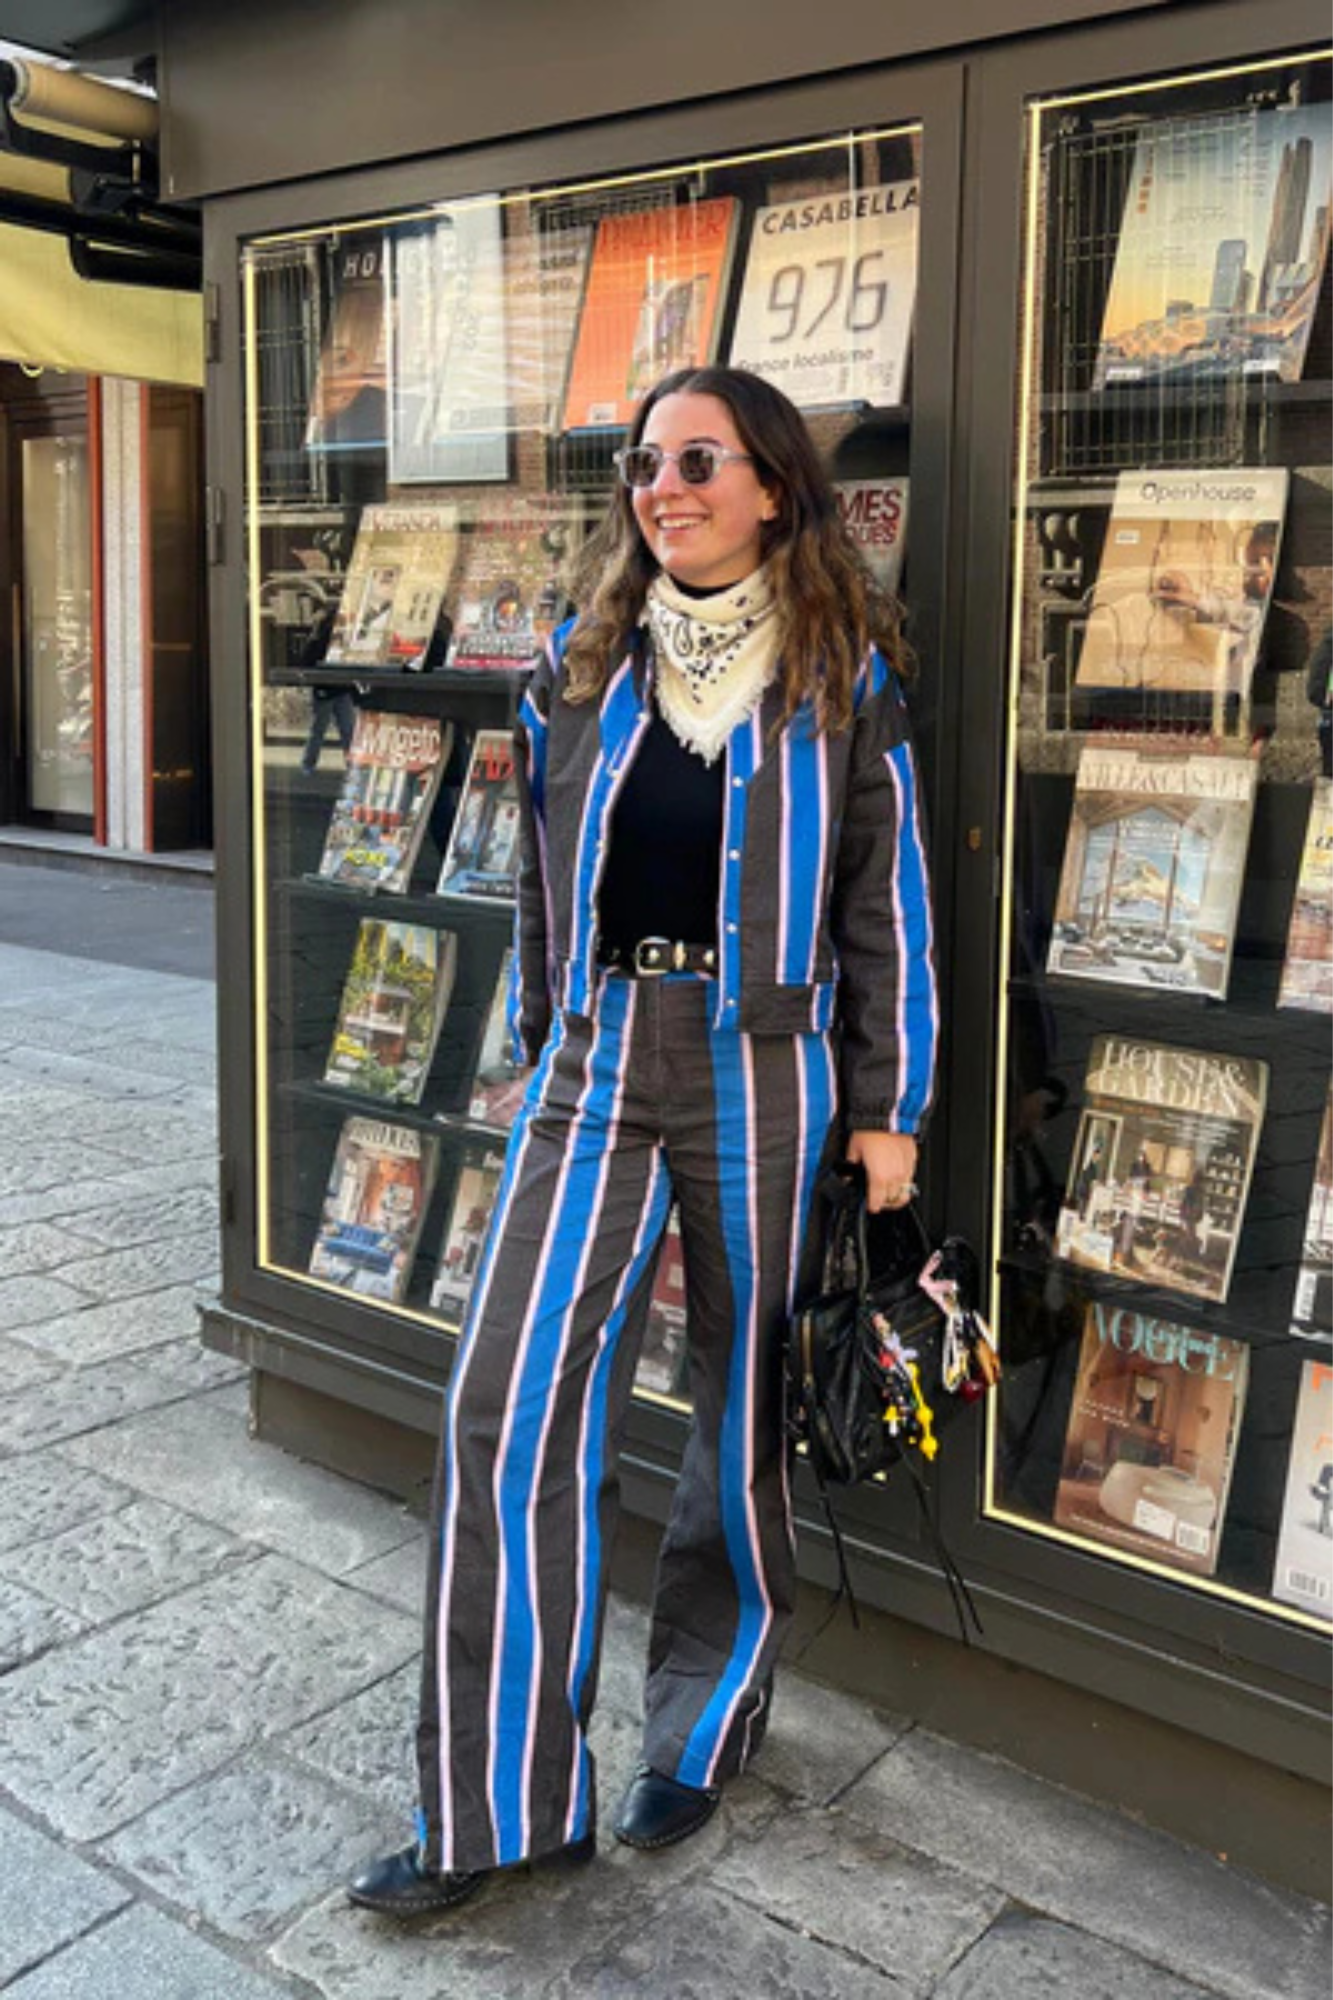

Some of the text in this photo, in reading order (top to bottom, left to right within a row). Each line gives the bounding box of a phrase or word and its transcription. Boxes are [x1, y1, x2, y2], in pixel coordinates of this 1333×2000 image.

[762, 185, 918, 234] CASABELLA
[768, 250, 887, 344] 976
[1141, 482, 1256, 504] Openhouse
